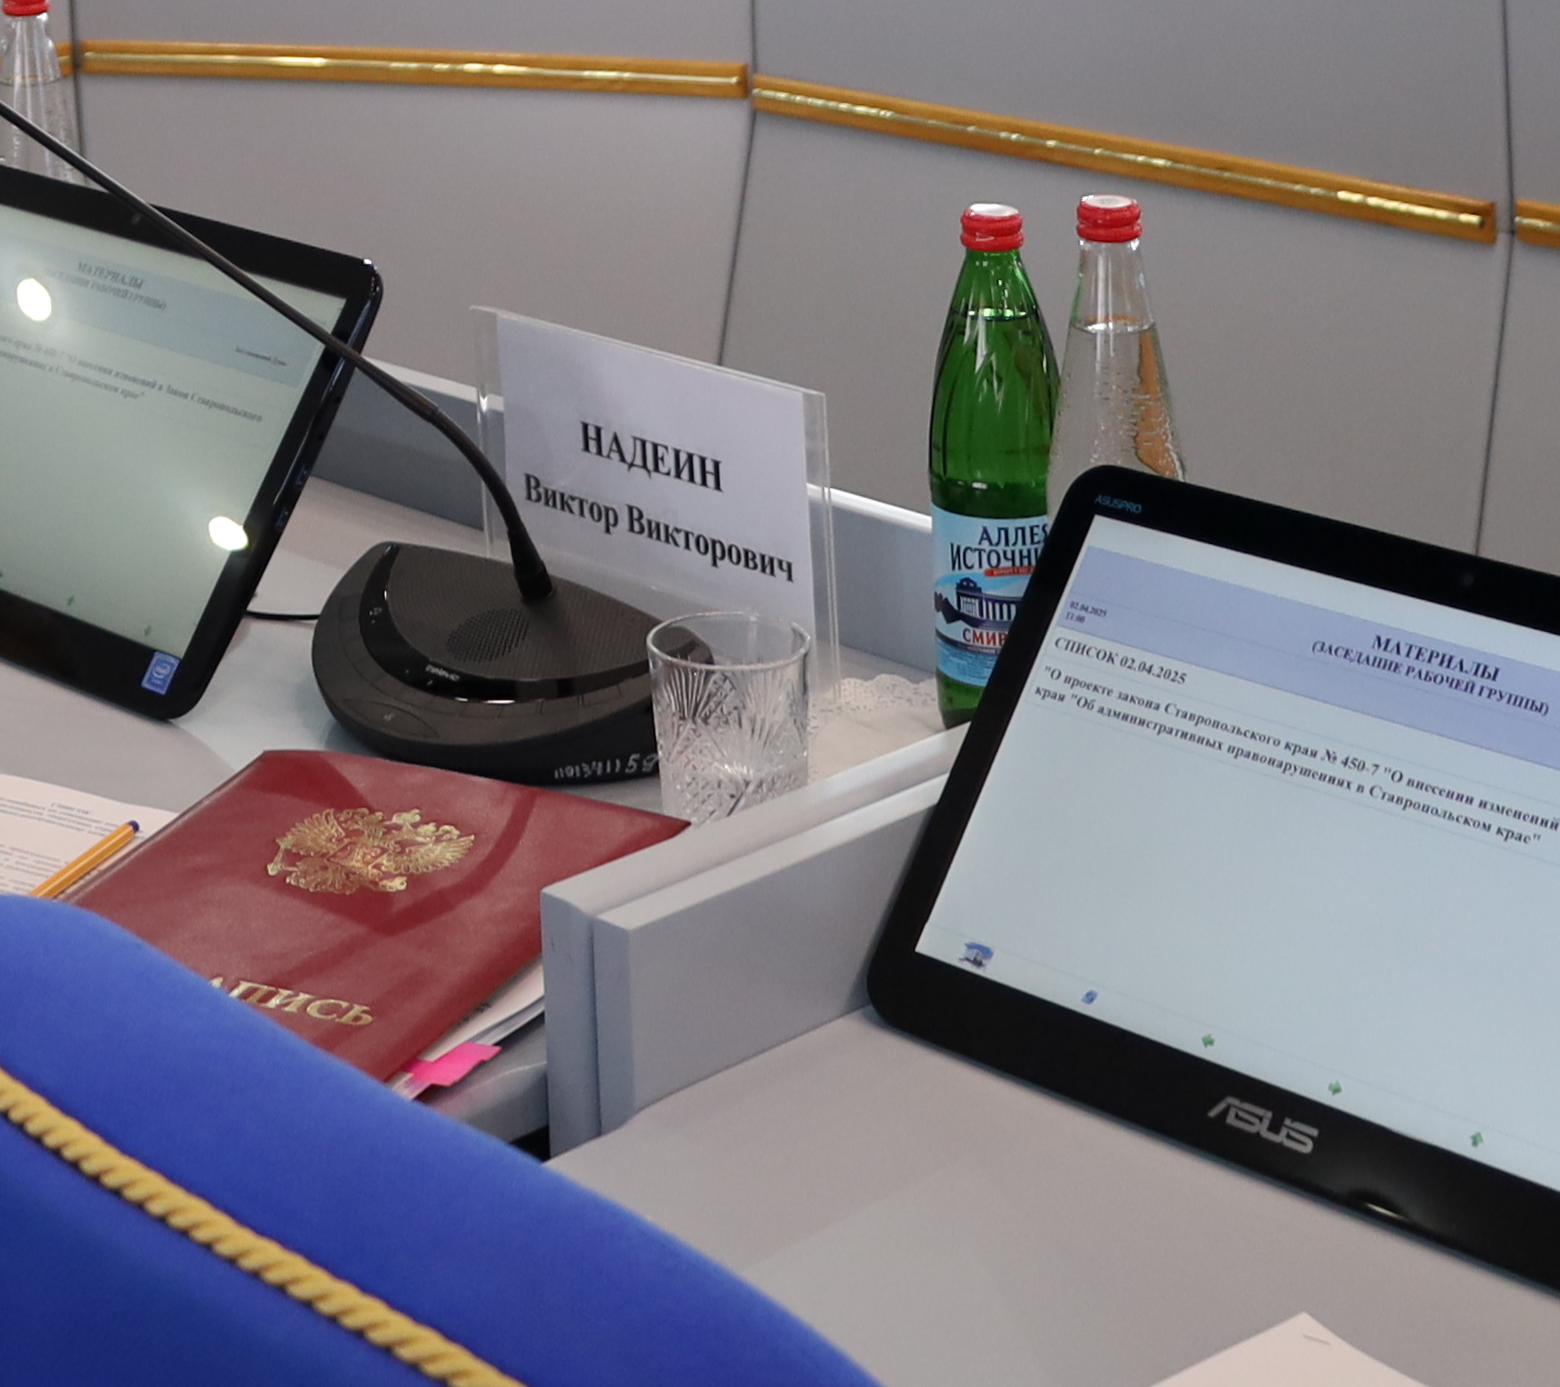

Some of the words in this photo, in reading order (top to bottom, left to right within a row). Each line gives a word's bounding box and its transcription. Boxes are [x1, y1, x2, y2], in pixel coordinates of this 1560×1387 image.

[579, 420, 724, 492] НАДЕИН
[524, 472, 619, 535] Виктор
[625, 503, 795, 583] Викторович
[1094, 493, 1143, 515] ASUSPRO
[950, 541, 1043, 572] ИСТОЧН
[1054, 636, 1119, 666] СПИСОК
[1120, 655, 1188, 685] 02.04.2025
[1311, 639, 1404, 675] (ЗАСЕДАНИЕ
[1405, 664, 1477, 695] РАБОЧЕЙ
[1477, 684, 1550, 717] ГРУППЫ)
[1371, 634, 1501, 683] МАТЕРИАЛЫ
[1034, 684, 1066, 703] края
[1070, 693, 1095, 711] "Об
[1097, 704, 1224, 752] административных
[1227, 743, 1353, 791] правонарушениях
[1355, 783, 1366, 794] в
[1369, 784, 1492, 834] Ставропольском
[1495, 826, 1542, 845] крае"
[1044, 664, 1062, 681] "О
[1063, 674, 1114, 699] проекте
[1116, 687, 1161, 712] закона
[1164, 702, 1281, 749] Ставропольского
[1284, 740, 1319, 761] края
[1340, 753, 1380, 778] 450-7
[1406, 776, 1475, 807] внесении
[1478, 798, 1560, 832] изменений
[1206, 1095, 1320, 1155] ASUS
